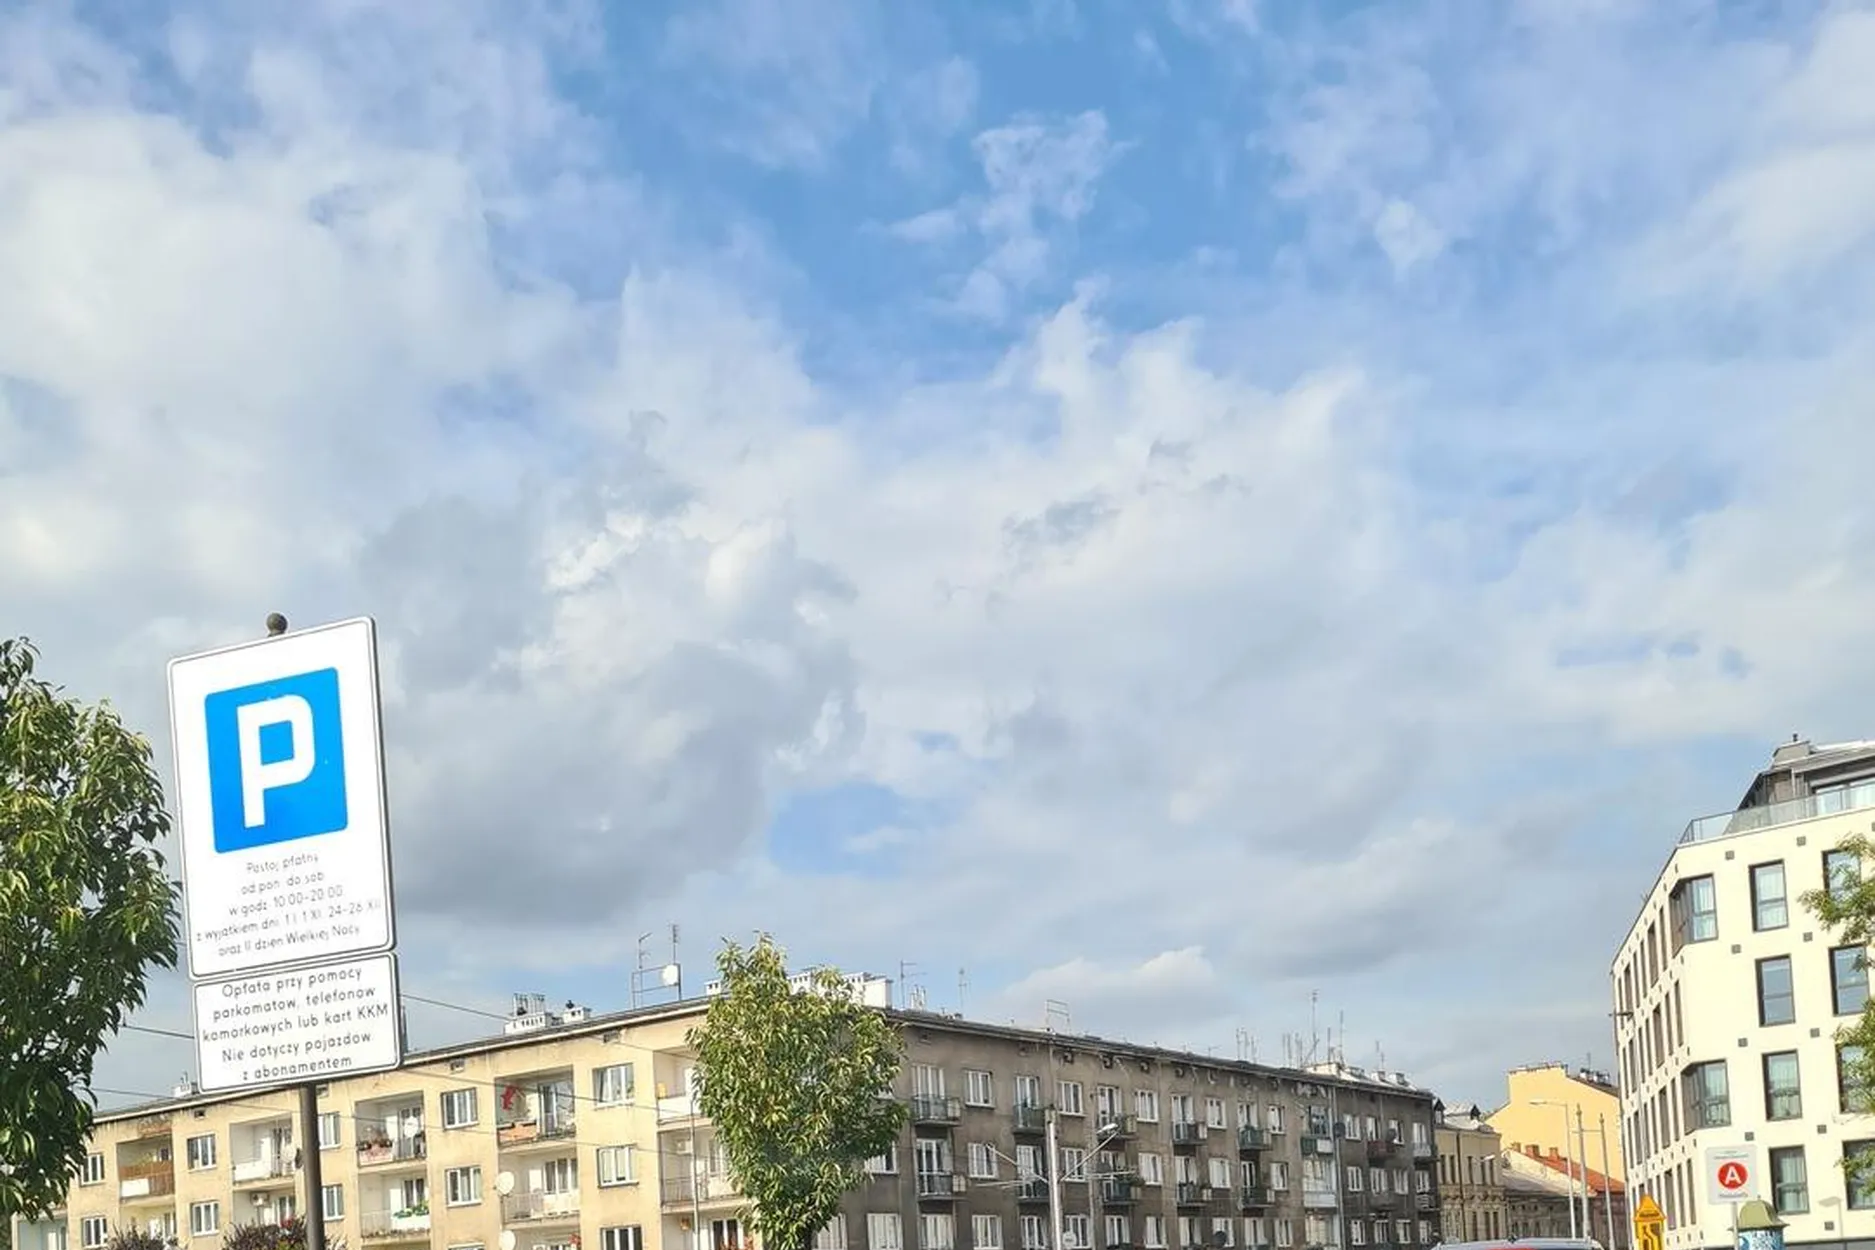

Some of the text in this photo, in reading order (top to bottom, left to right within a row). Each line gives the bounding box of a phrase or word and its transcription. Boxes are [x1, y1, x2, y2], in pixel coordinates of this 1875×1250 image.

[237, 694, 316, 828] P
[241, 881, 256, 895] od
[228, 907, 238, 916] w
[276, 976, 303, 994] przy
[308, 967, 362, 989] pomocy
[297, 1013, 319, 1029] lub
[324, 1008, 352, 1025] kart
[357, 1002, 388, 1020] KKM
[222, 1048, 245, 1063] Nie
[249, 1042, 300, 1060] dotyczy
[242, 1056, 353, 1081] z abonamentem
[1725, 1165, 1742, 1186] A
